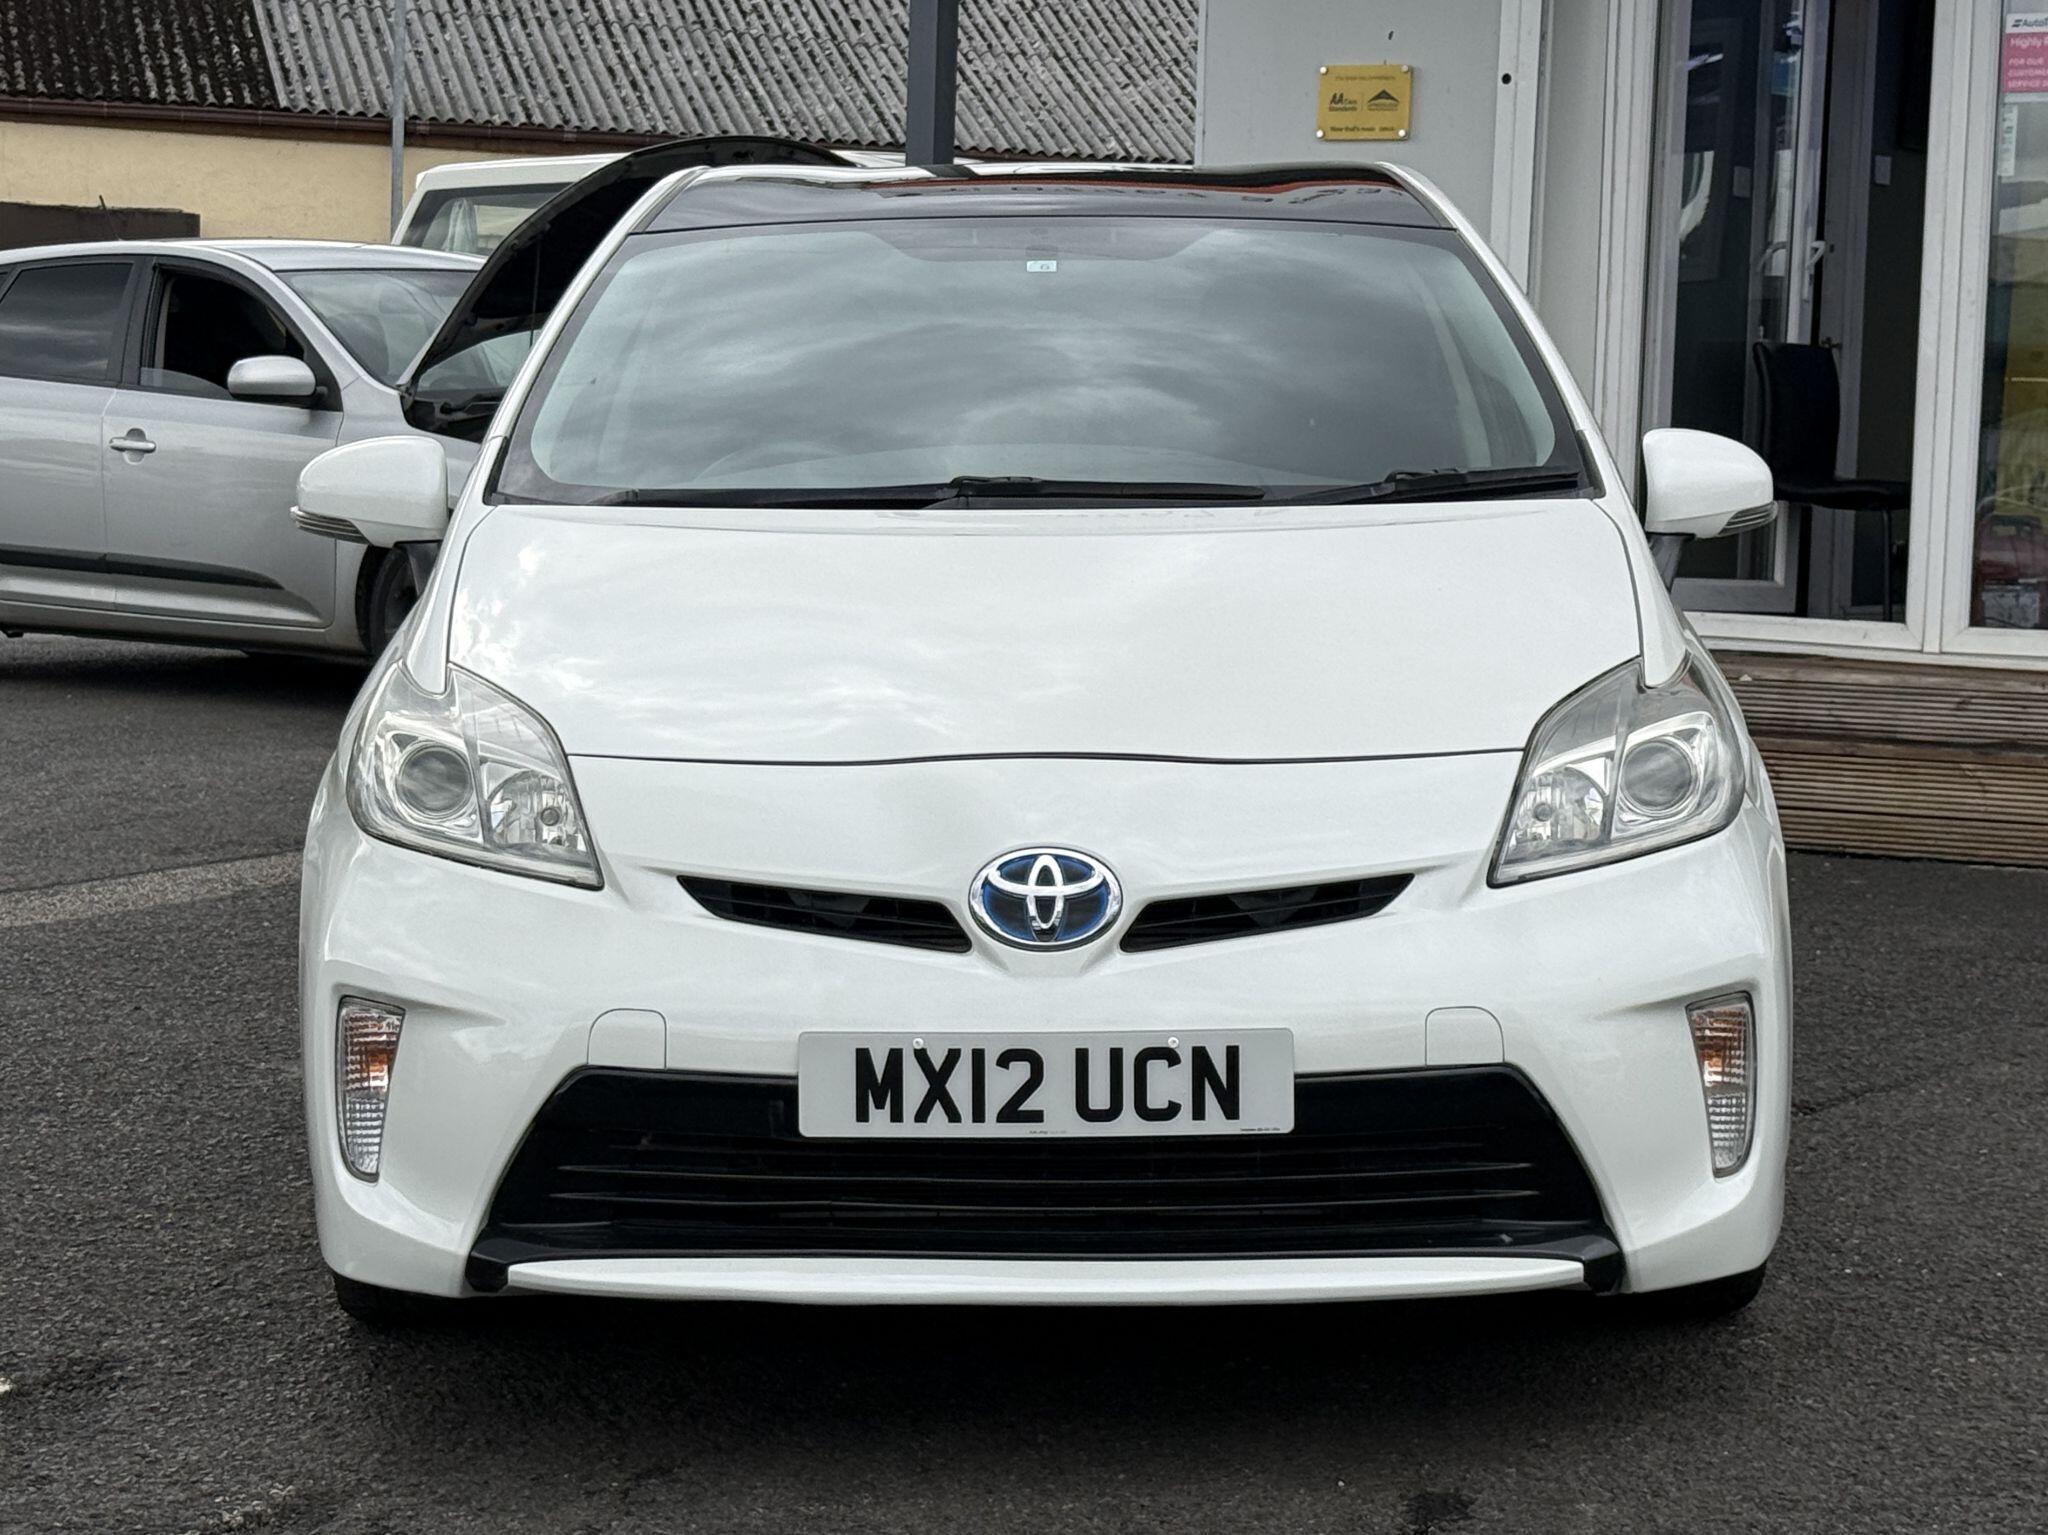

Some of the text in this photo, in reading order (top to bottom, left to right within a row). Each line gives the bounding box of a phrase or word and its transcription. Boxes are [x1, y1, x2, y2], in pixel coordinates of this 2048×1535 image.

[2010, 36, 2042, 50] Highly
[855, 1045, 1241, 1124] MX12 UCN
